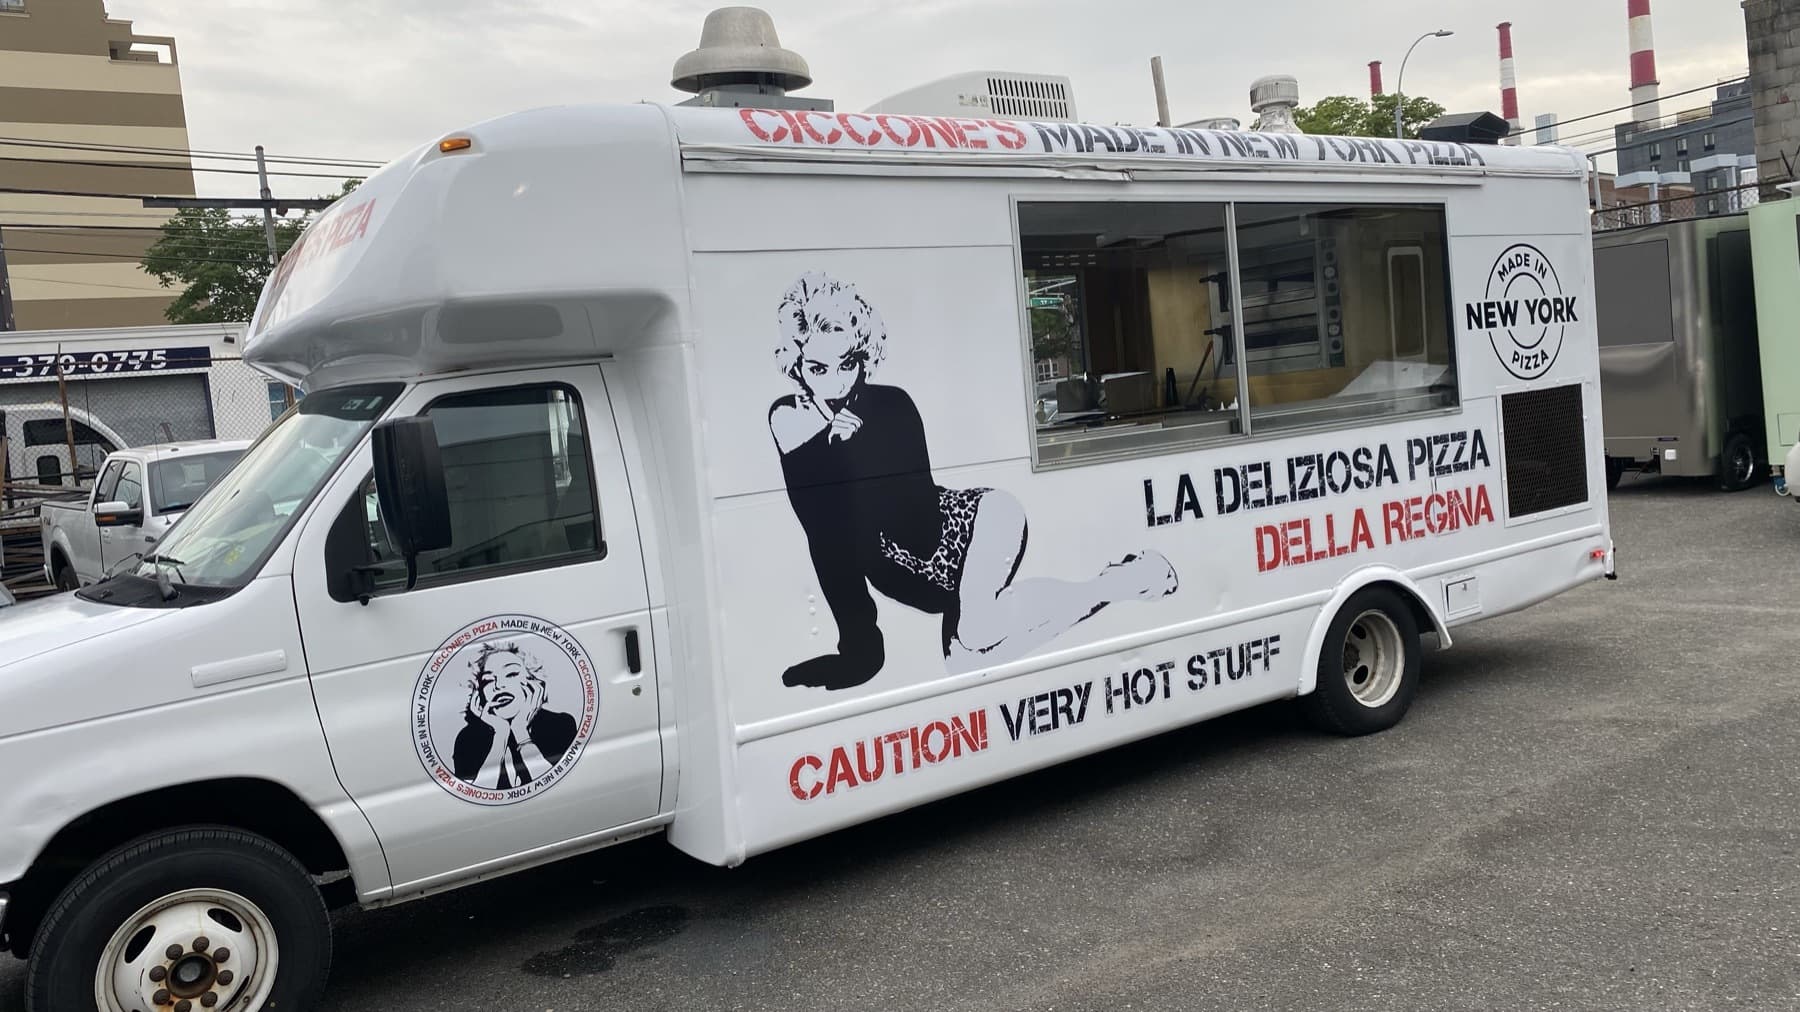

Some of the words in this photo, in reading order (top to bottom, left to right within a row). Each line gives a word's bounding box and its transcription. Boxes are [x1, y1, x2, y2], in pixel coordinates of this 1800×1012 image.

[739, 109, 1027, 150] CICCONE'S
[1030, 122, 1166, 154] MADE
[1169, 128, 1212, 156] IN
[1216, 131, 1299, 159] NEW
[1310, 135, 1401, 165] YORK
[1400, 140, 1486, 167] PIZZA
[1497, 252, 1531, 282] MADE
[1534, 258, 1548, 279] IN
[1466, 299, 1519, 330] NEW
[1524, 296, 1579, 325] YORK
[1511, 349, 1550, 371] PIZZA
[1143, 473, 1204, 528] LA
[1214, 443, 1399, 516] DELIZIOSA
[1406, 428, 1491, 481] PIZZA
[1255, 508, 1375, 573] DELLA
[1382, 484, 1495, 545] REGINA
[430, 632, 472, 674] CICCONE'S
[472, 621, 498, 637] PIZZA
[500, 619, 529, 629] MADE
[530, 622, 541, 631] IN
[540, 625, 562, 641] NEW
[561, 637, 581, 660] YORK
[418, 674, 435, 700] YORK
[416, 703, 426, 728] NEW
[578, 714, 593, 739] PIZZA
[788, 709, 989, 801] CAUTION!
[1000, 681, 1093, 742] VERY
[1104, 661, 1176, 715] HOT
[1187, 634, 1281, 692] STUFF
[417, 728, 428, 740] IN
[420, 741, 438, 768] MADE
[561, 740, 583, 767] MADE
[434, 766, 456, 788] PIZZA
[534, 771, 555, 794] NEW
[553, 765, 565, 776] IN
[456, 783, 504, 801] CICCONE'S
[507, 786, 533, 801] YORK
